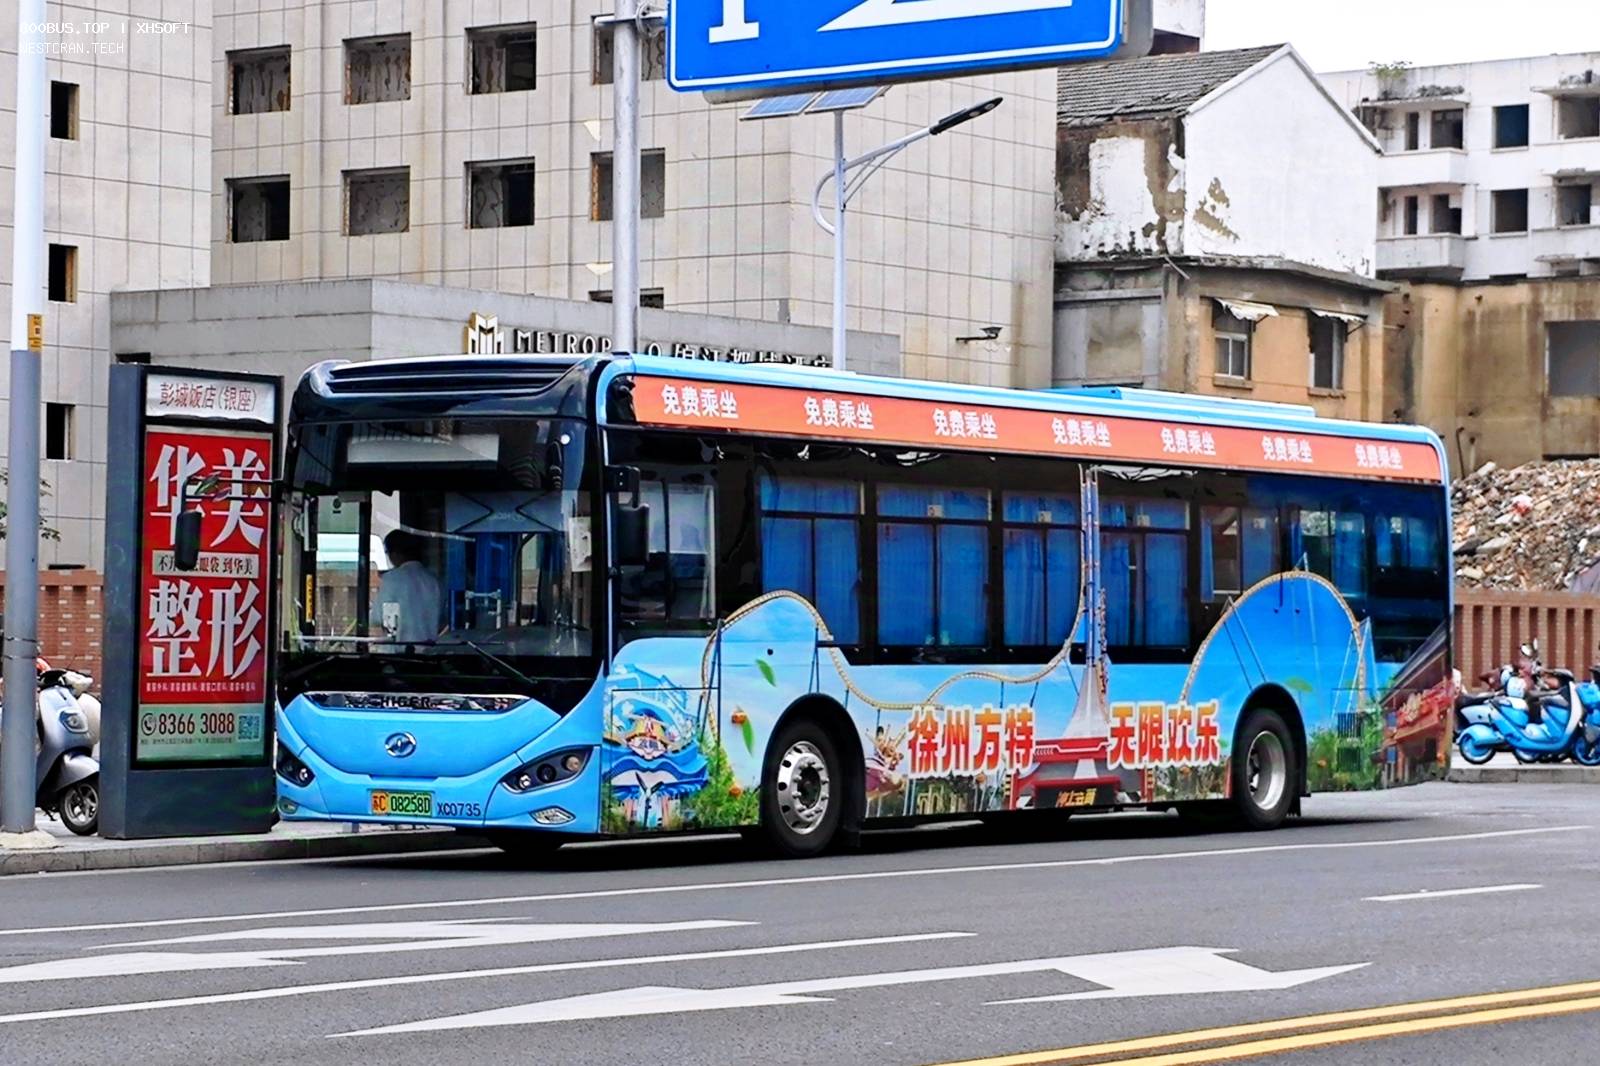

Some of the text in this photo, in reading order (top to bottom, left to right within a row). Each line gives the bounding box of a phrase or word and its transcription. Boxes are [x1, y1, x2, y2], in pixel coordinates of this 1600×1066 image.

[660, 383, 1405, 471] 免费乘坐 免费乘坐 免费乘坐 免费乘坐 免费乘坐 免费乘坐 免费乘坐
[150, 444, 266, 549] 华美
[146, 578, 262, 680] 整形
[158, 712, 235, 735] 8366 3088
[907, 700, 1222, 777] 徐州方特 无限欢乐
